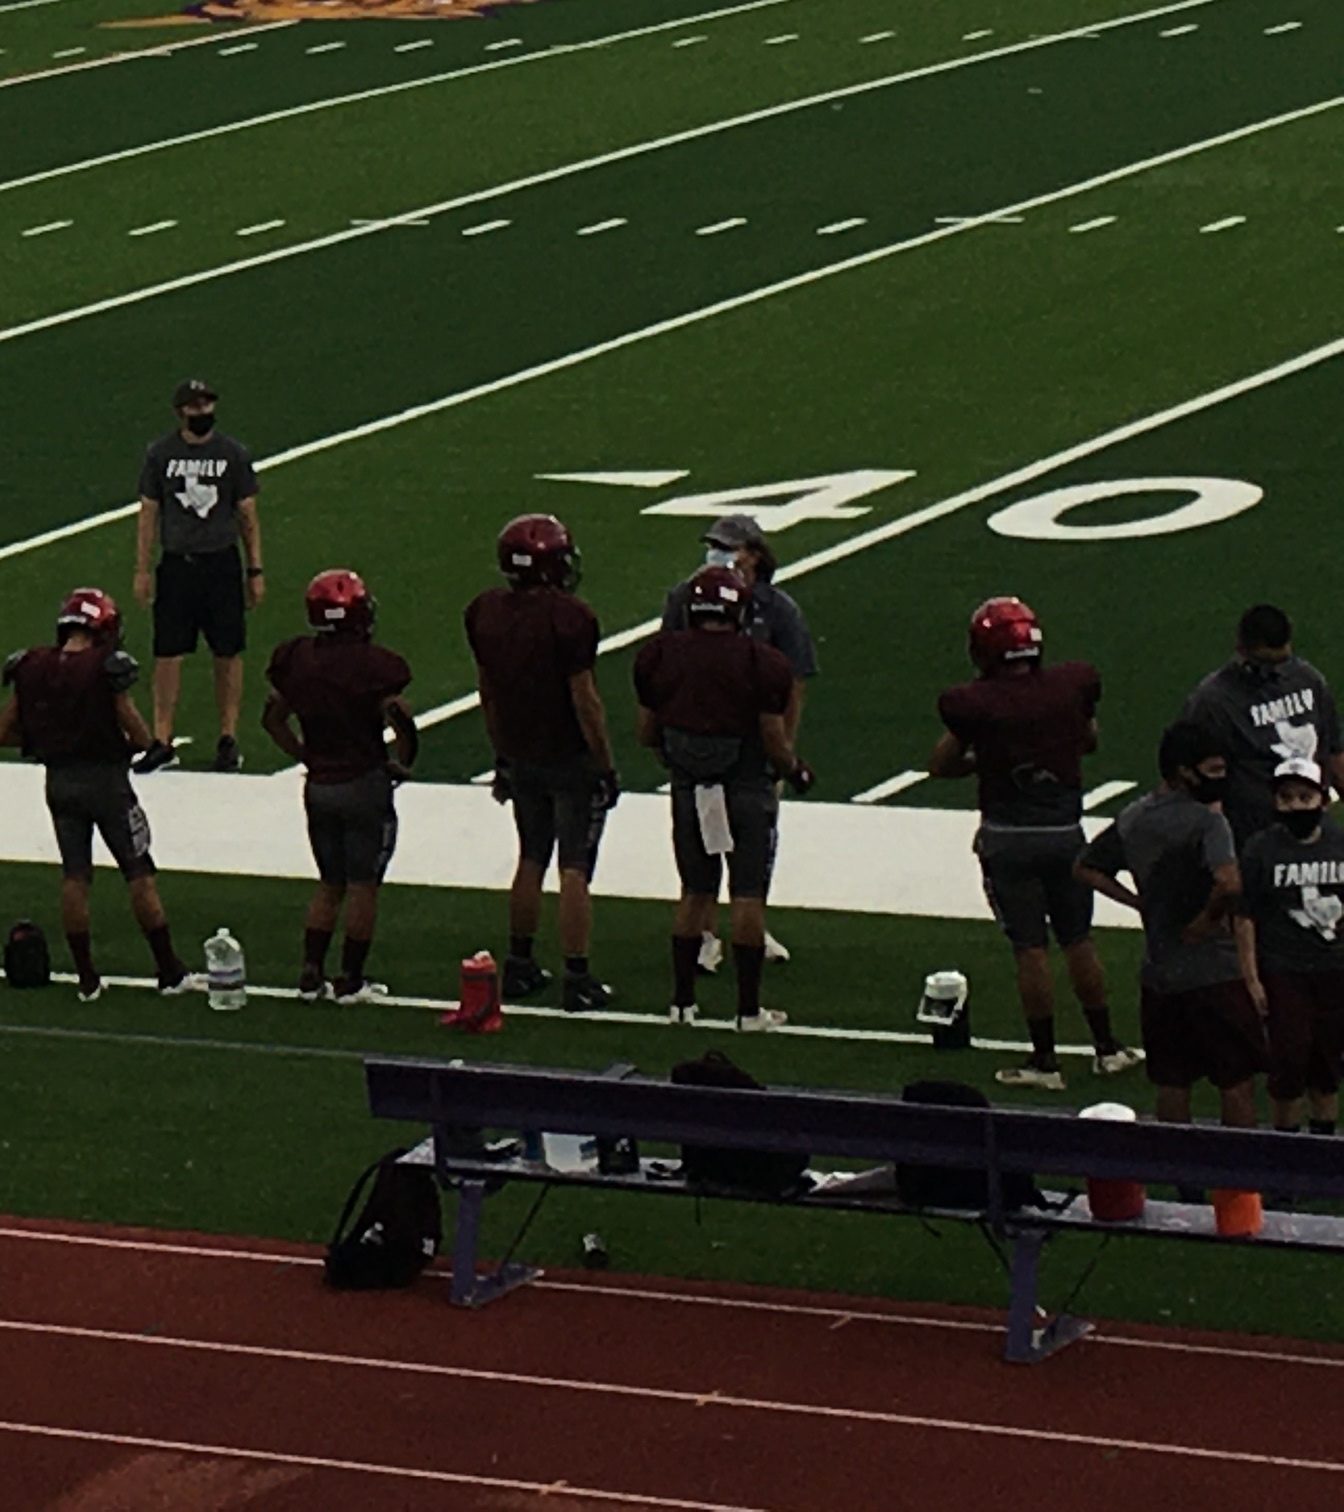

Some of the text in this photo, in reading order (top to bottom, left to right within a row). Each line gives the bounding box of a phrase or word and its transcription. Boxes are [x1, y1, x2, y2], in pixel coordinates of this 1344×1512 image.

[165, 458, 229, 478] FAMILY
[639, 469, 1264, 541] 40
[1248, 688, 1315, 728] FAMILY
